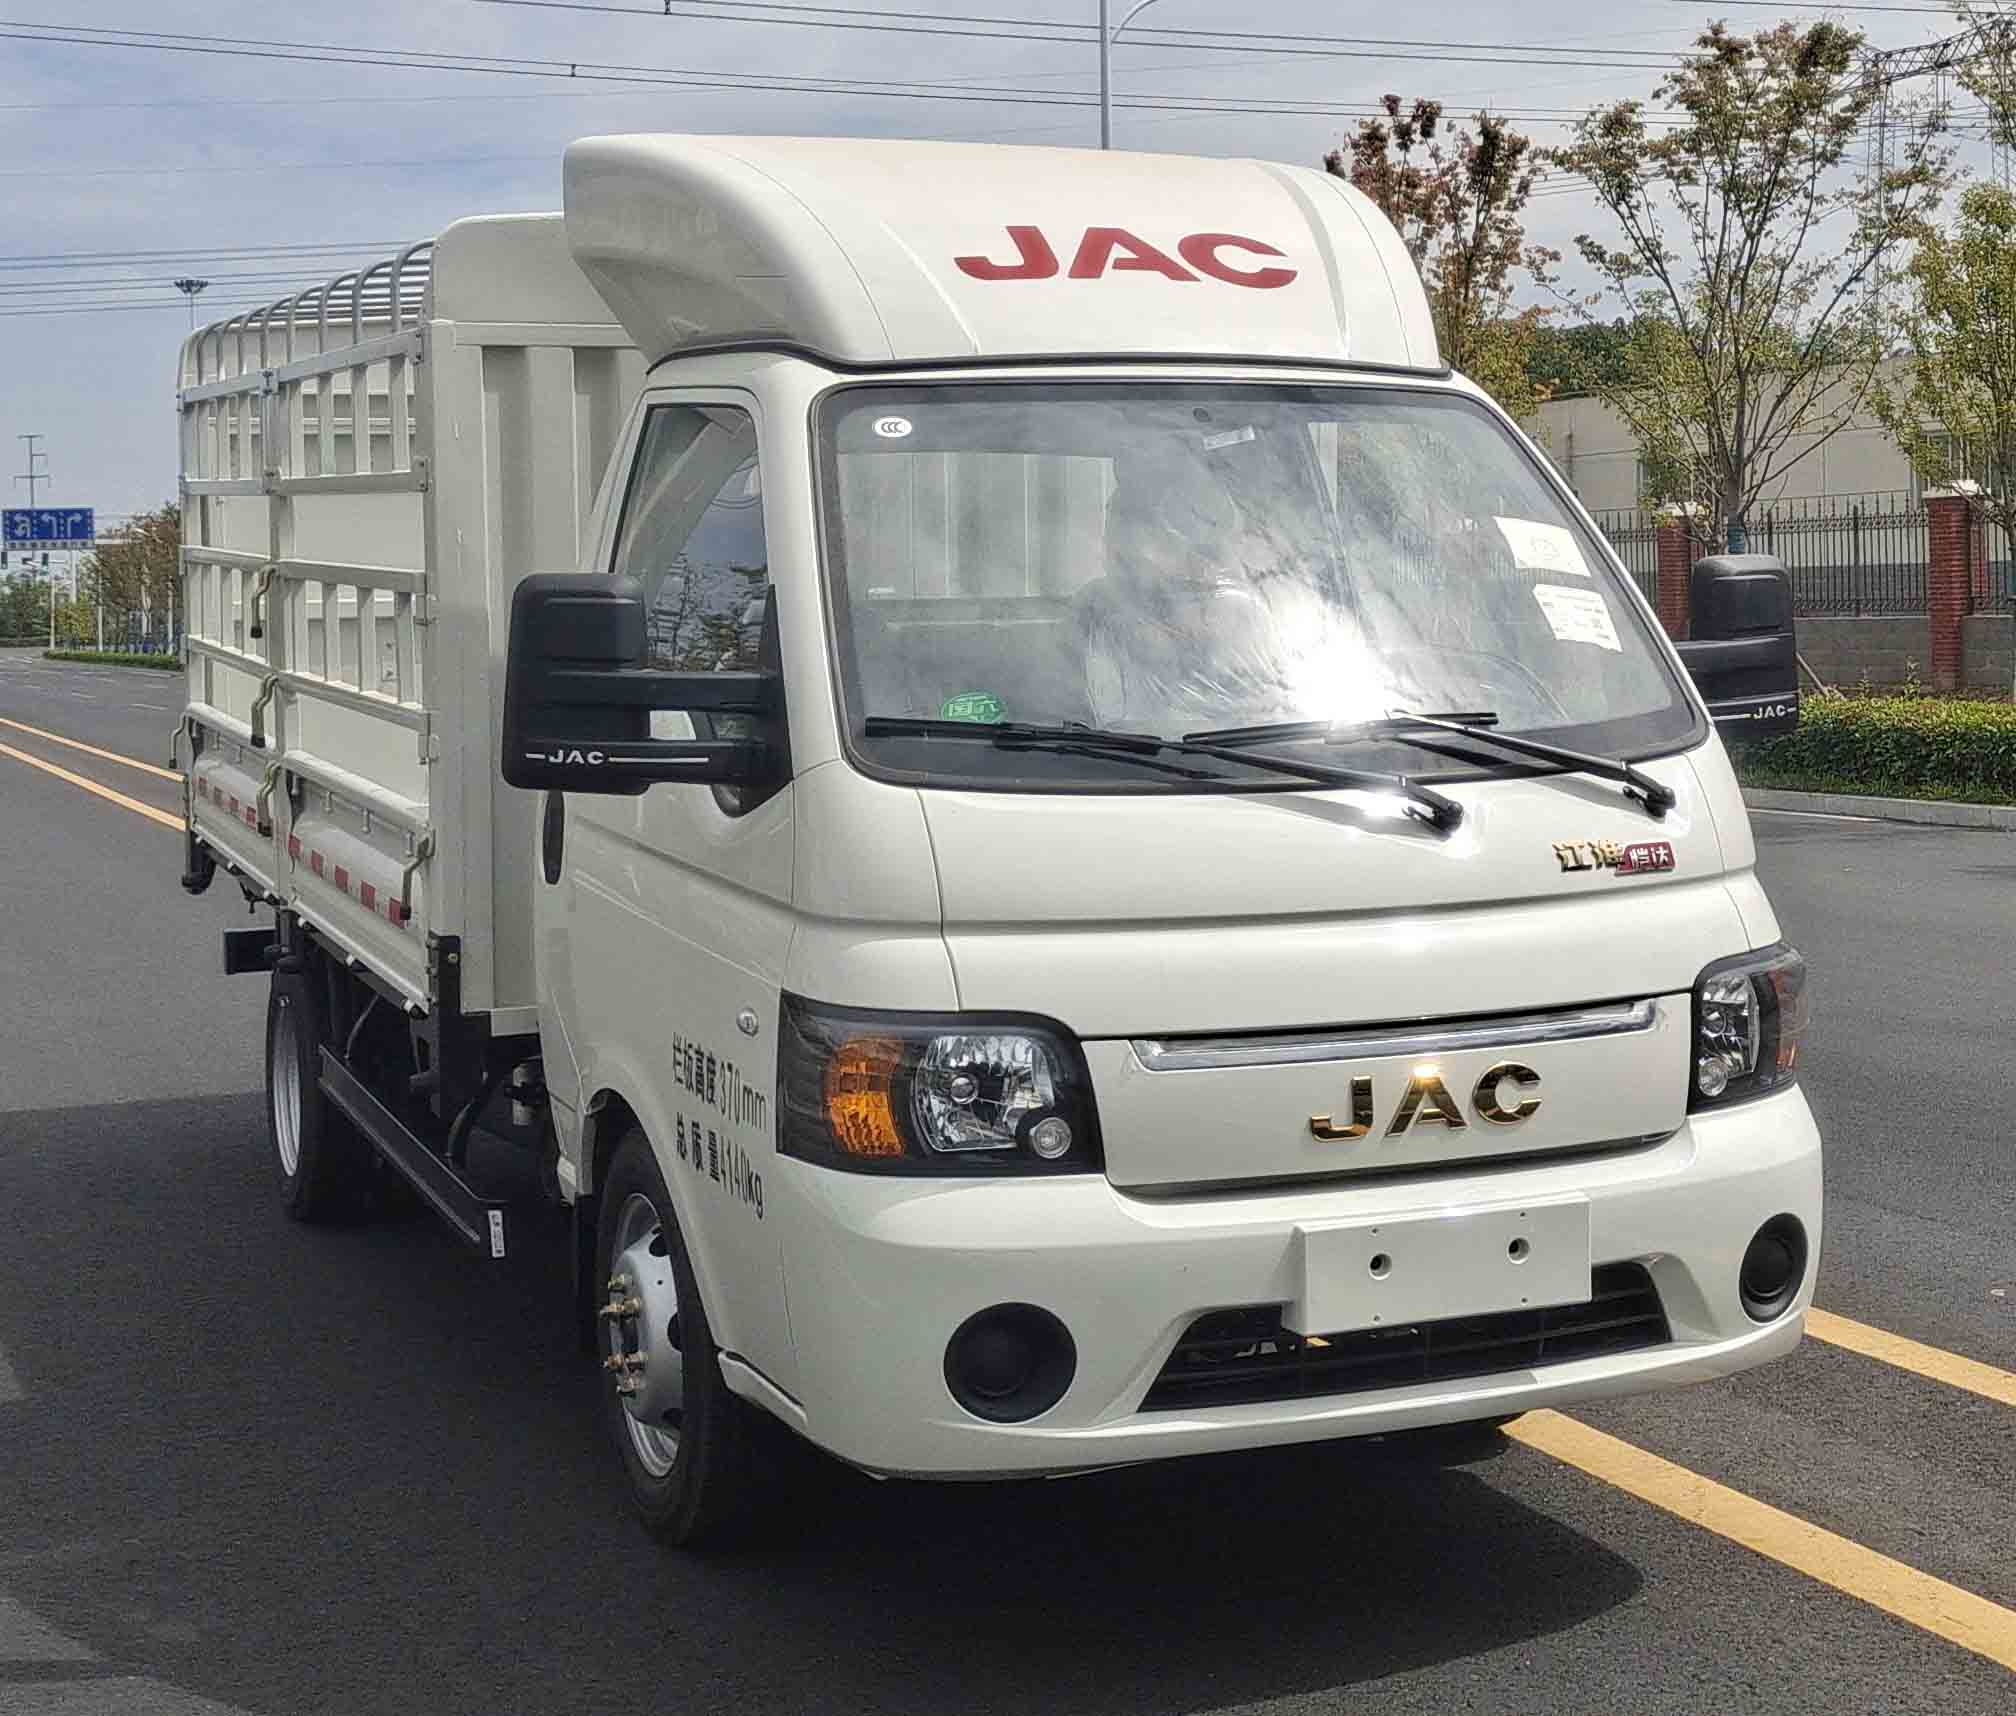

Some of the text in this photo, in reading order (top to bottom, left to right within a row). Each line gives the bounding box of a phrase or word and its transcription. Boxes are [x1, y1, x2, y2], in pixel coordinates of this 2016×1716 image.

[953, 225, 1298, 289] JAC
[1753, 705, 1786, 719] JAC
[549, 750, 604, 765] JAC
[1310, 1060, 1543, 1143] JAC
